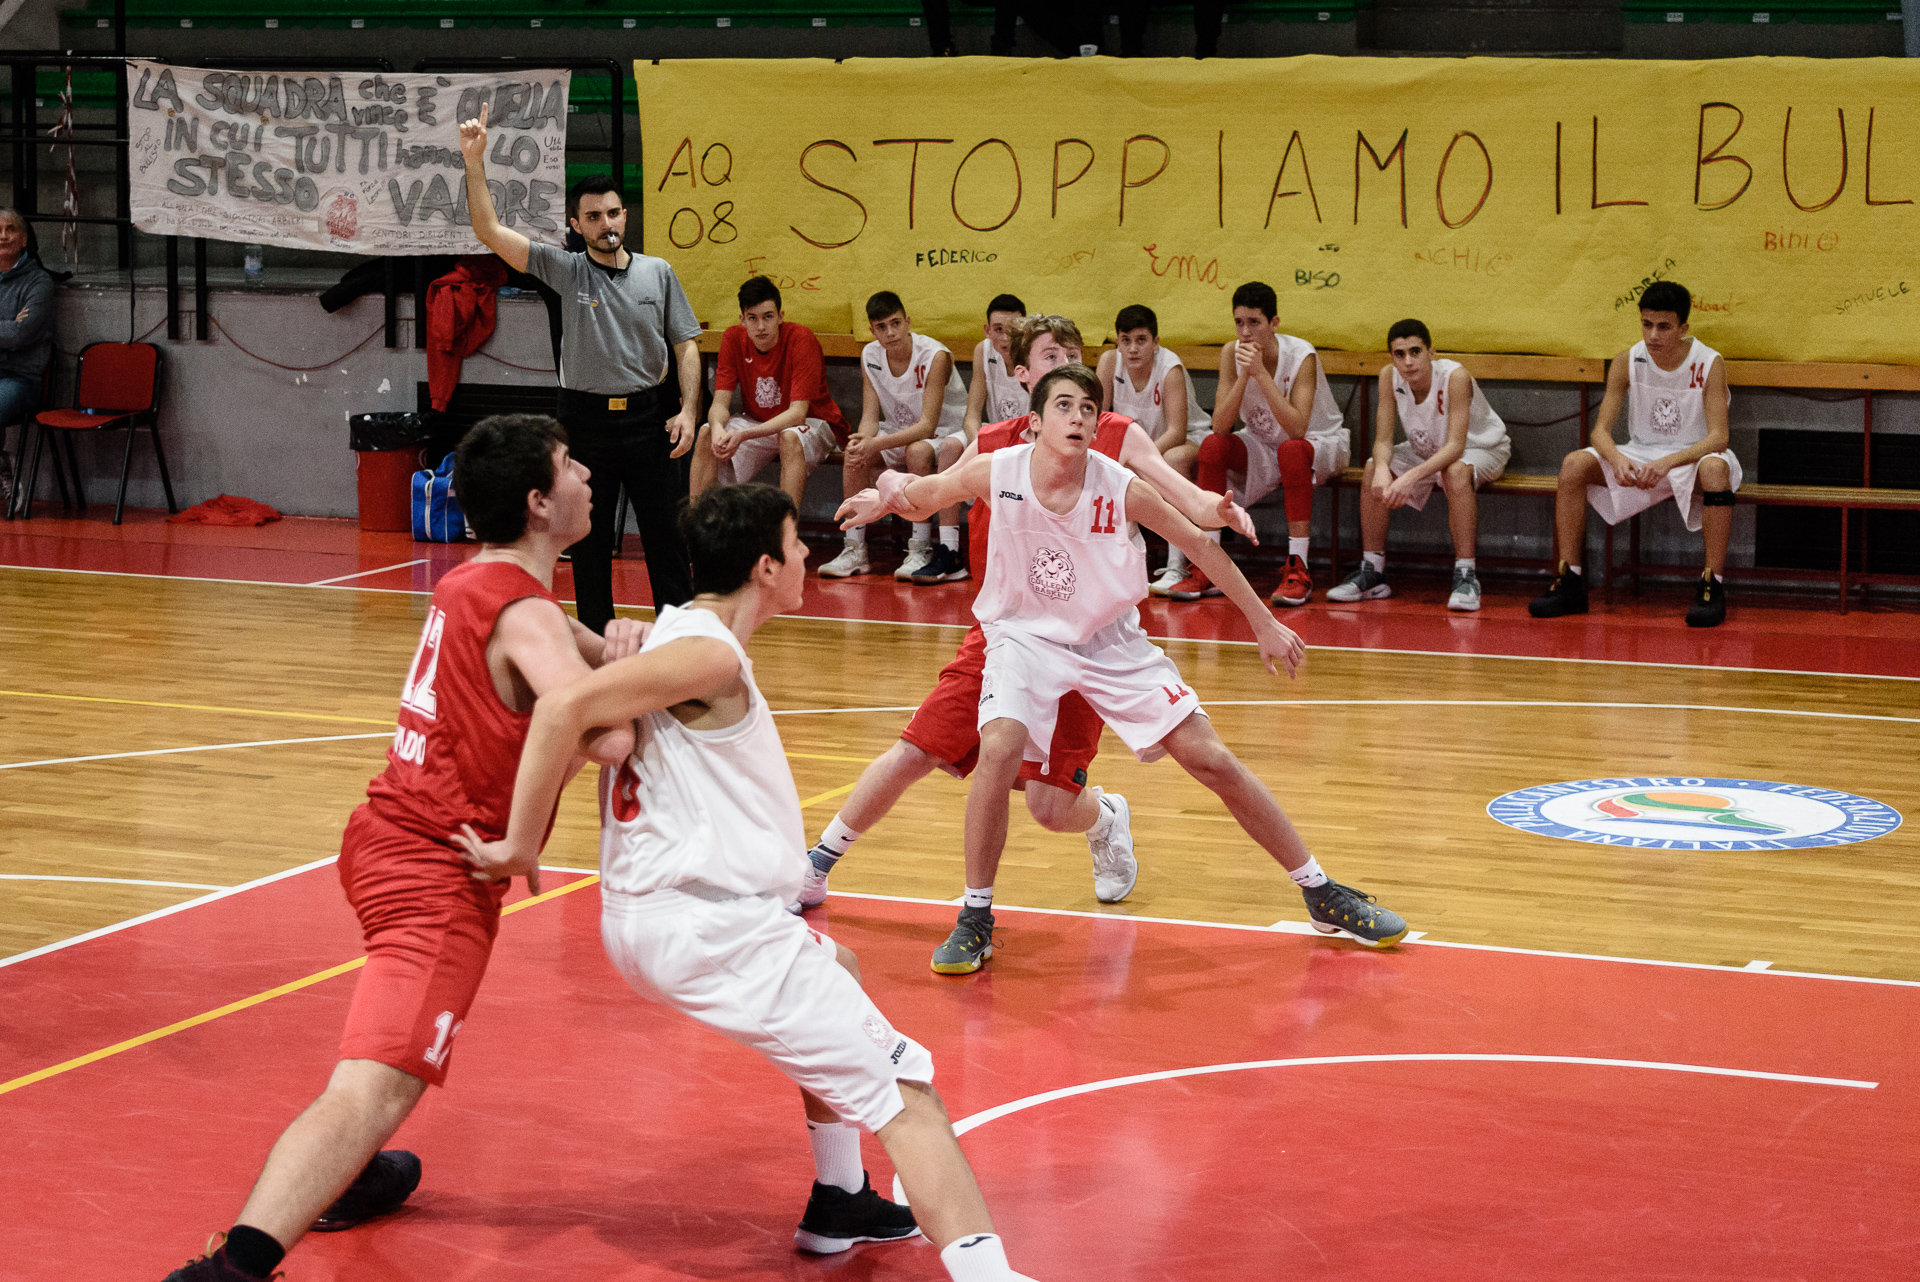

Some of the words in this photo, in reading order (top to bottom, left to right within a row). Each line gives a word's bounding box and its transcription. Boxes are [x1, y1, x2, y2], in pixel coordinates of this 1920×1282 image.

[133, 68, 184, 113] LA
[196, 72, 347, 120] SQUADRA
[358, 75, 407, 104] che
[164, 117, 199, 153] IN
[210, 121, 264, 152] CUI
[274, 122, 388, 174] TUTTI
[491, 134, 540, 173] LO
[658, 137, 733, 192] AQ
[167, 151, 319, 211] STESSO
[388, 173, 557, 231] VALORE
[790, 128, 1493, 249] STOPPIAMO
[1546, 115, 1649, 215] IL
[1695, 102, 1914, 213] BUL
[916, 248, 997, 267] FEDERICO
[1142, 243, 1228, 290] Ema
[1295, 269, 1341, 290] BISO
[1836, 281, 1910, 315] SAMUELE
[1689, 362, 1705, 388] 14
[1091, 496, 1115, 533] 11
[1030, 577, 1073, 592] COLLEGNO
[1034, 585, 1071, 599] BASKET
[1492, 777, 1706, 828] PALLACANESTRO
[1769, 784, 1897, 844] FEDERAZIONE
[1564, 830, 1791, 850] ITALIANA
